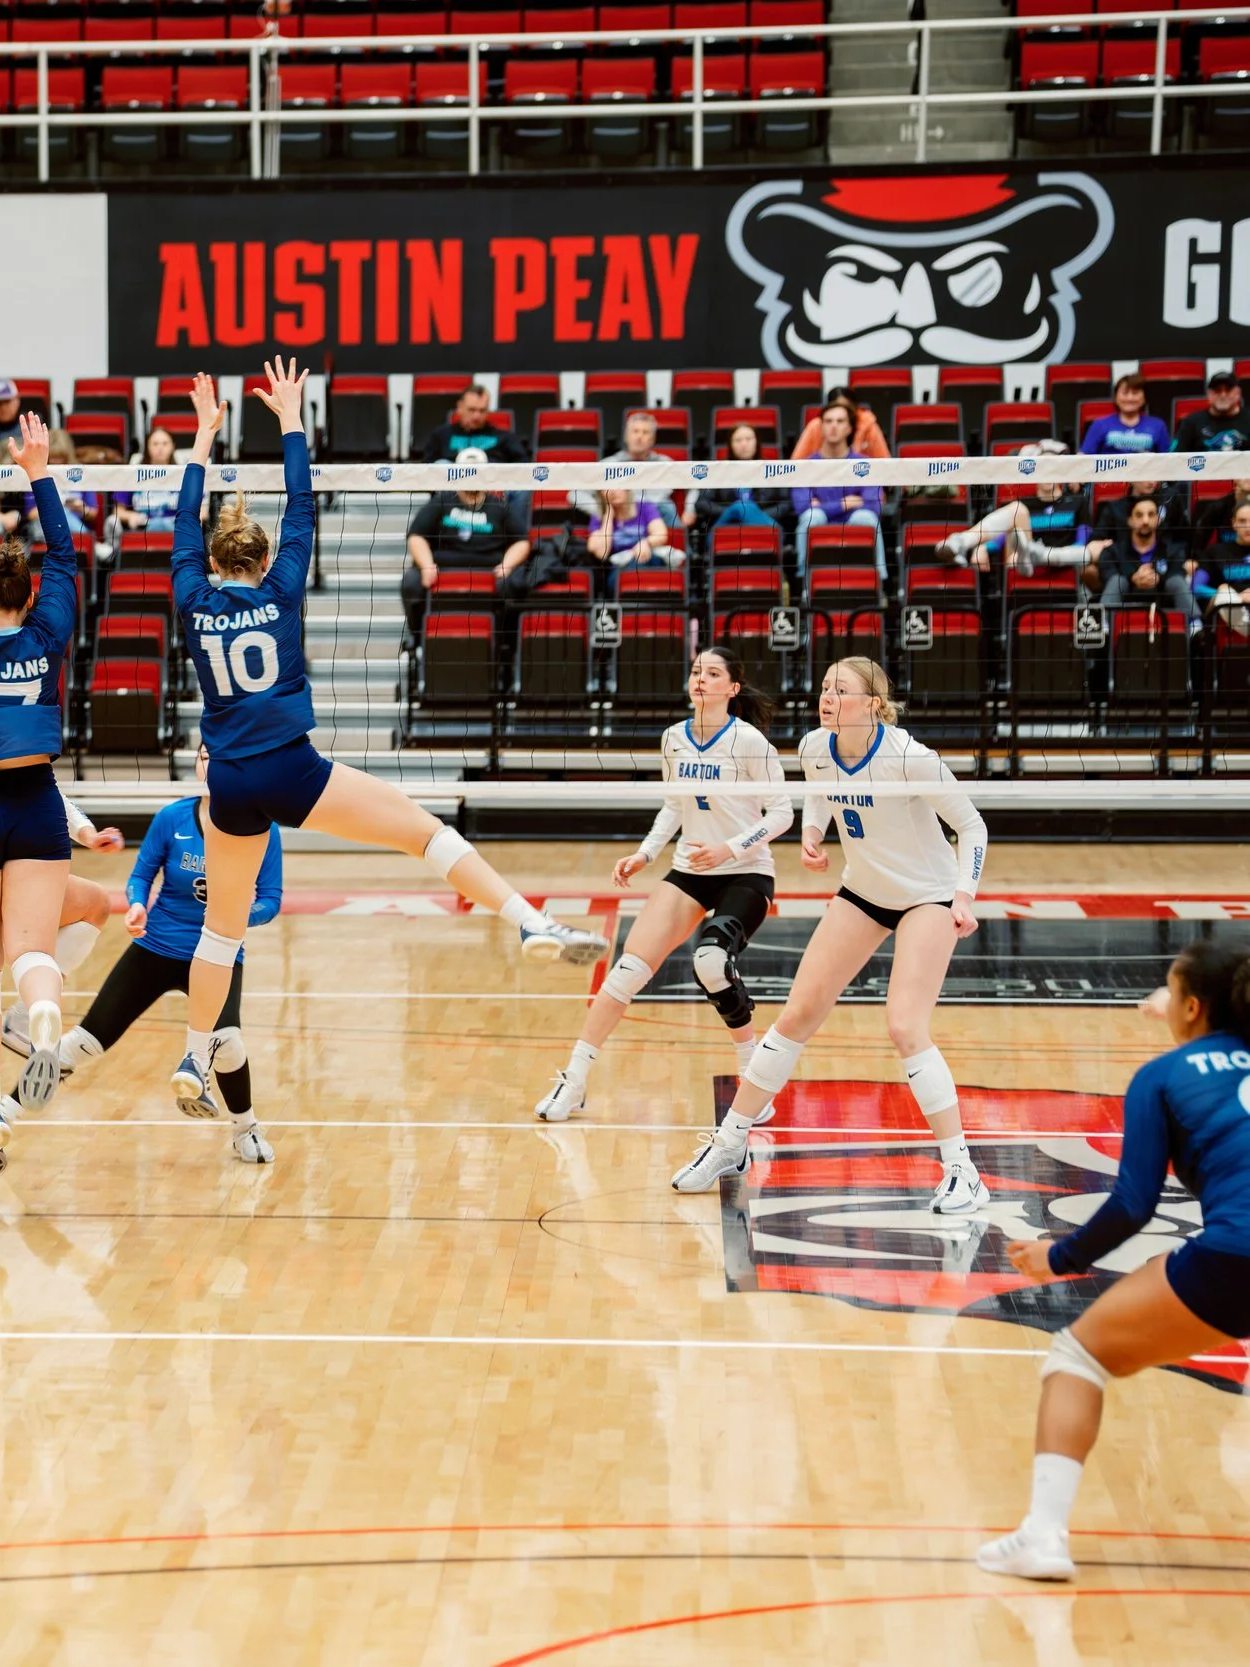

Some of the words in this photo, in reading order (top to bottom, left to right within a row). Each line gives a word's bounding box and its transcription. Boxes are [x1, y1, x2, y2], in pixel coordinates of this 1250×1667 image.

[155, 240, 463, 347] AUSTIN
[490, 234, 699, 342] PEAY
[765, 464, 796, 478] NJCAA
[928, 462, 959, 476] NJCAA
[1095, 459, 1127, 473] NJCAA
[137, 468, 166, 482] NJCAA
[447, 467, 477, 481] NJCAA
[605, 467, 635, 481] NJCAA
[192, 603, 280, 632] TROJANS
[200, 631, 280, 697] 10
[678, 762, 721, 780] BARTON
[842, 808, 865, 840] 9
